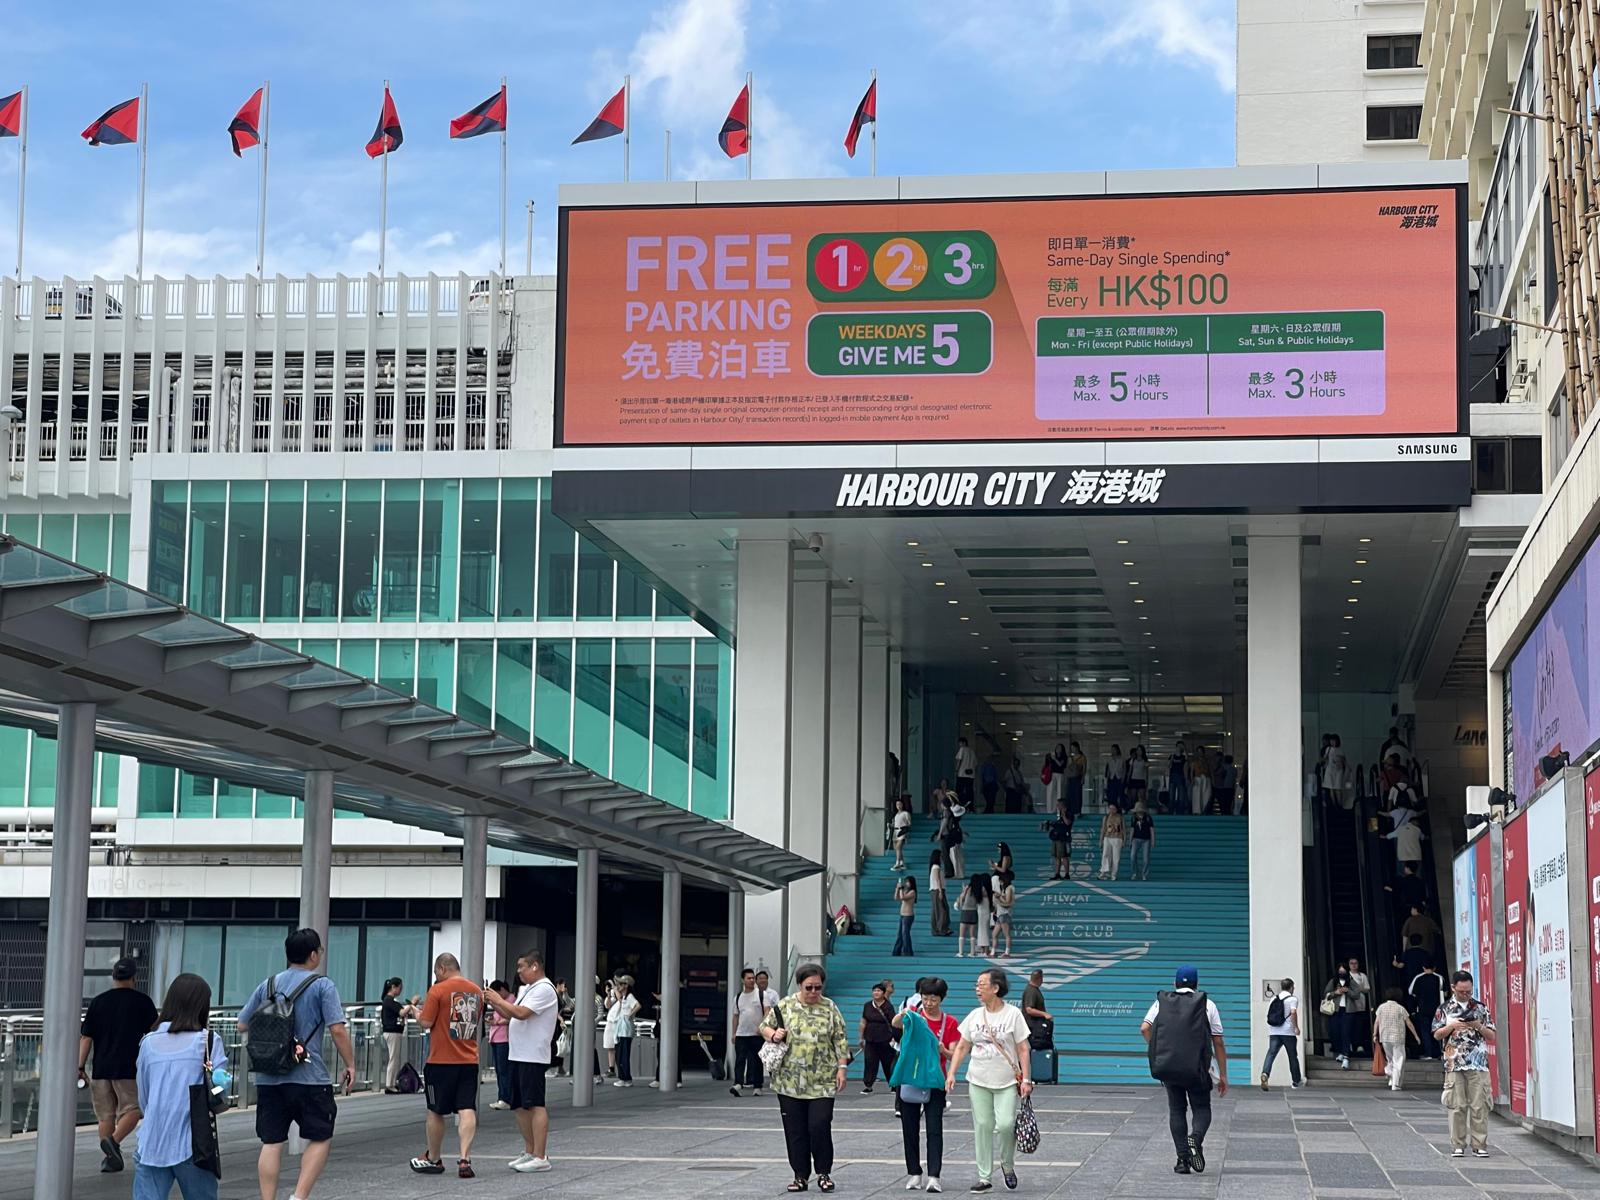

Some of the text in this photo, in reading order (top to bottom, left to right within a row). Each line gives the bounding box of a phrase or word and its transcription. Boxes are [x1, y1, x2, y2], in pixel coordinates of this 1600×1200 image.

[1379, 204, 1438, 216] HARBOUR CITY
[1400, 215, 1439, 229] 海港城
[626, 234, 792, 291] FREE
[832, 245, 848, 287] 1
[885, 243, 926, 286] 2 hrs
[944, 242, 972, 285] 3
[1048, 253, 1114, 268] Same-Day
[1118, 252, 1158, 267] Single
[1048, 277, 1079, 293] 每滿
[1099, 270, 1228, 310] HK$100
[1048, 294, 1088, 310] Every
[625, 298, 792, 332] PARKING
[838, 324, 927, 340] WEEKDAYS
[1067, 328, 1113, 338] 星期一至五
[932, 324, 960, 366] 5
[1051, 341, 1070, 350] Mon
[1078, 340, 1090, 349] Fri
[1092, 340, 1123, 350] (except
[1125, 339, 1151, 348] Public
[1154, 338, 1193, 350] Holidays)
[1238, 335, 1354, 347] Sat, Sun & Public Holidays
[621, 338, 791, 380] 免費泊車
[838, 345, 926, 366] GIVE ME
[1073, 375, 1101, 389] 最多
[1134, 374, 1161, 387] 小時
[1248, 372, 1276, 386] 最多
[1284, 368, 1304, 400] 3
[1310, 370, 1337, 384] 小時
[1110, 371, 1128, 402] 5
[1248, 388, 1276, 399] Max.
[1310, 386, 1346, 398] Hours
[1073, 390, 1101, 402] Max.
[1133, 390, 1168, 401] Hours
[1398, 444, 1458, 454] SAMSUNG
[836, 468, 1166, 507] HARBOUR CITY 海港城
[1041, 893, 1090, 906] JELLYCAT
[1013, 924, 1113, 938] YACHT CLUB
[976, 1023, 1006, 1033] Mdi
